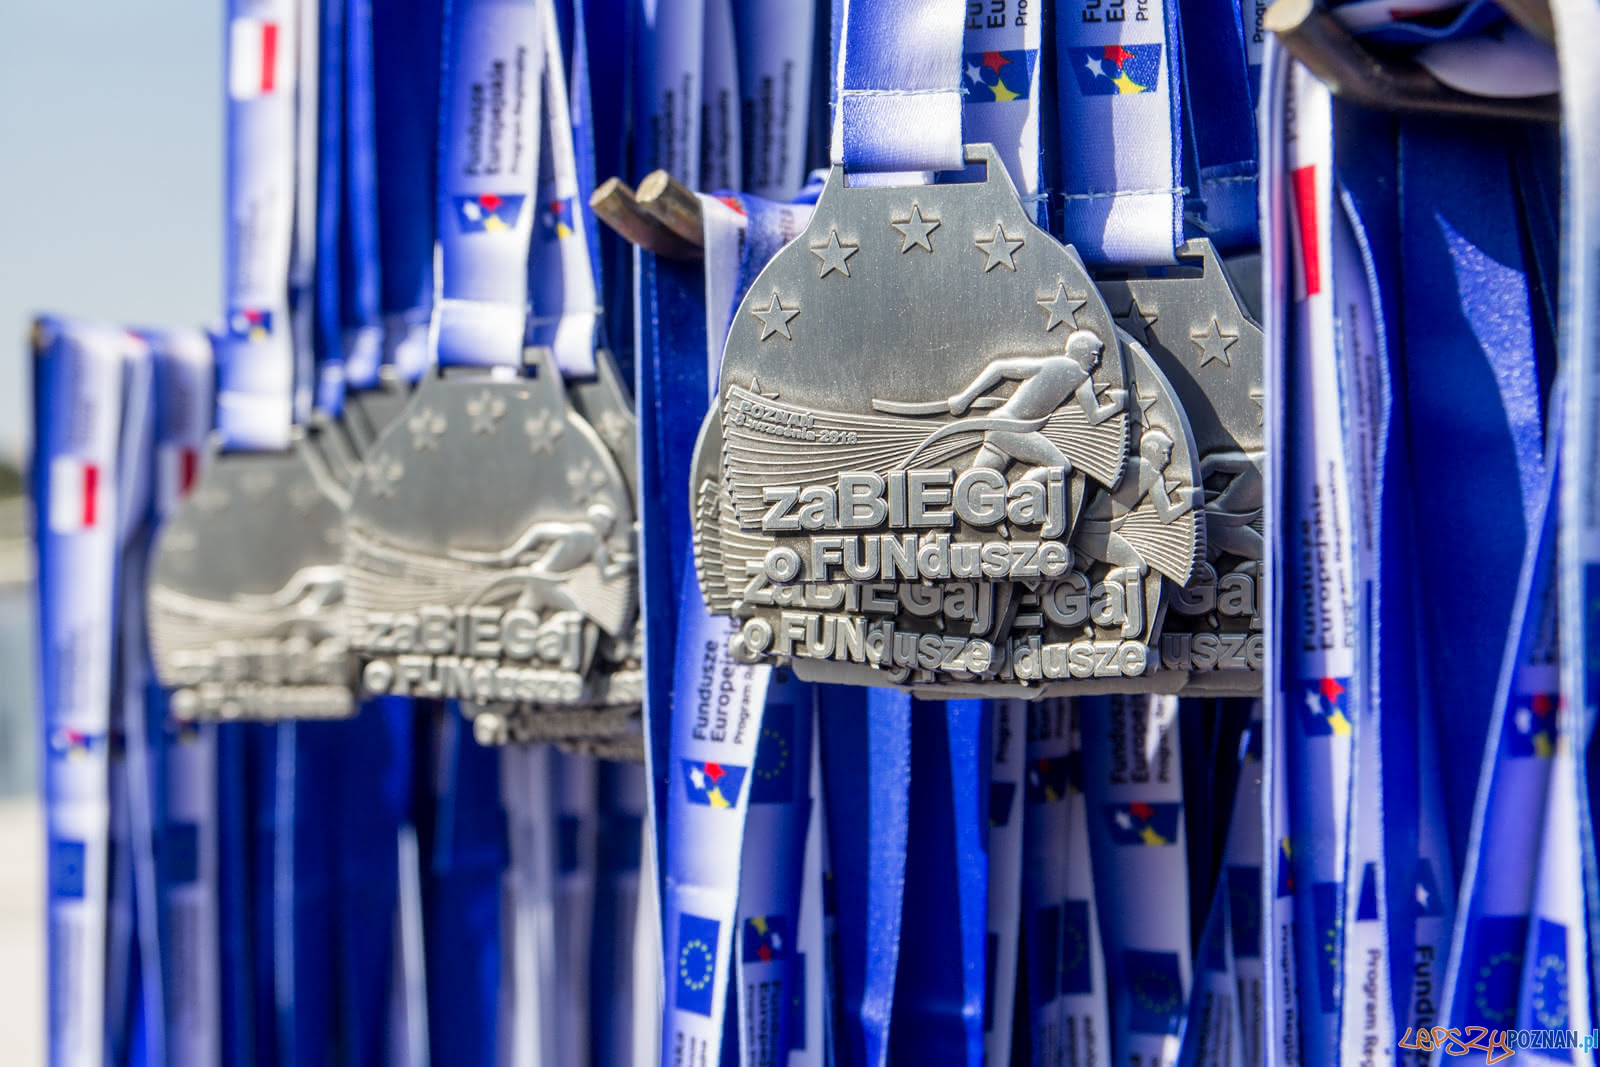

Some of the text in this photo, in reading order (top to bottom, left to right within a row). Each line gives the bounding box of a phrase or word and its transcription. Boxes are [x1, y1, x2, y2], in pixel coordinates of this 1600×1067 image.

[762, 465, 1070, 539] zaBIEGaj
[764, 532, 1073, 584] o FUNdusze
[781, 611, 995, 673] FUNdusze
[692, 639, 719, 741] Fundusze
